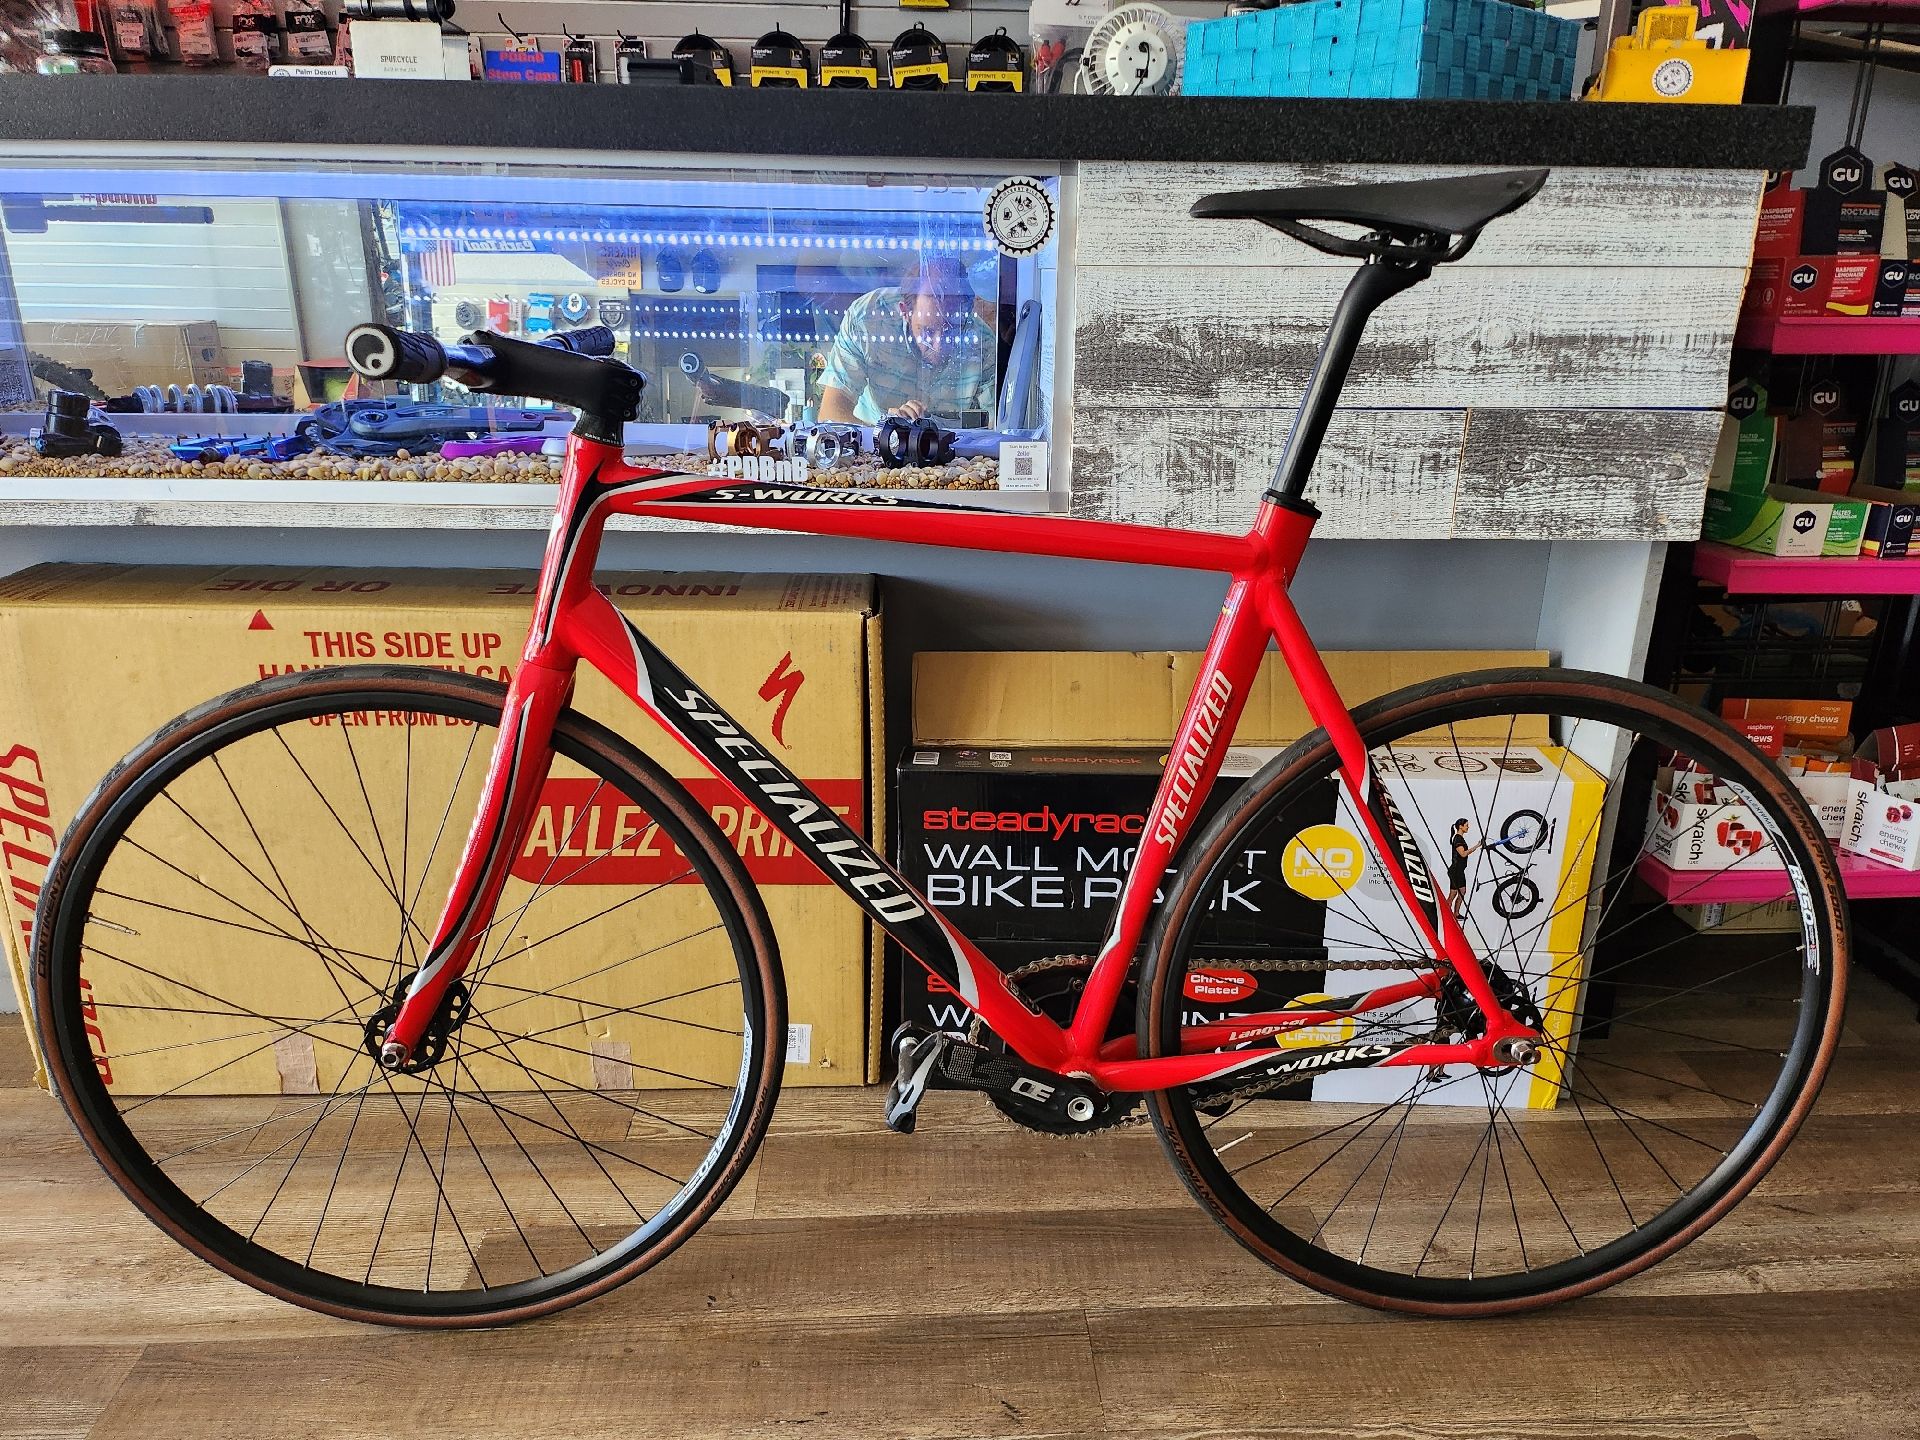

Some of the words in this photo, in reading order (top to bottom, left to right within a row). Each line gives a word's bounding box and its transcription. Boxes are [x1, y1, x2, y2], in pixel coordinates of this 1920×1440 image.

[294, 14, 316, 25] FOX
[295, 68, 313, 76] Palm
[1832, 167, 1860, 182] GU
[1888, 176, 1912, 189] GU
[1840, 208, 1881, 216] ROCTANE
[1793, 273, 1814, 284] GU
[1884, 271, 1904, 281] GU
[1731, 397, 1755, 410] GU
[1813, 391, 1836, 404] GU
[1899, 400, 1919, 412] GU
[707, 456, 809, 482] #PDBnB
[708, 489, 899, 505] S-WORKS
[1795, 517, 1814, 527] GU
[1895, 514, 1912, 523] GU
[203, 579, 307, 592] DIE
[311, 580, 393, 593] OR
[485, 583, 741, 597] INNOVTE
[304, 631, 377, 658] THIS
[384, 632, 454, 658] SIDE
[461, 633, 502, 659] UP
[308, 709, 368, 727] OPEN
[375, 710, 437, 727] FROM
[1809, 714, 1839, 723] chews
[1747, 723, 1775, 731] raspberry
[1745, 734, 1773, 743] hews
[1031, 755, 1142, 765] steadyrack
[1154, 669, 1233, 853] SPECIALIZED
[664, 686, 925, 923] SPECIALIZED
[923, 805, 1145, 841] steadyrac
[1821, 814, 1845, 822] chew
[522, 805, 660, 857] ALLEZ
[1879, 830, 1908, 844] energy
[1880, 839, 1906, 853] chews
[924, 843, 1059, 872] WALL
[1293, 846, 1353, 869] NO
[1293, 868, 1352, 879] LIFTING
[928, 875, 1065, 909] BIKE
[1788, 864, 1814, 925] R450
[1812, 844, 1834, 880] PRIX
[1826, 884, 1844, 933] 5000
[37, 854, 71, 978] CONTINENTAL
[1190, 974, 1245, 985] Chrome
[1194, 985, 1239, 995] Plated
[1228, 1018, 1309, 1041] Langster
[1285, 1032, 1342, 1042] LIFTING
[750, 1085, 768, 1134] GRAND
[734, 1131, 753, 1164] PRIX
[1166, 1121, 1228, 1218] CONTINENTAL
